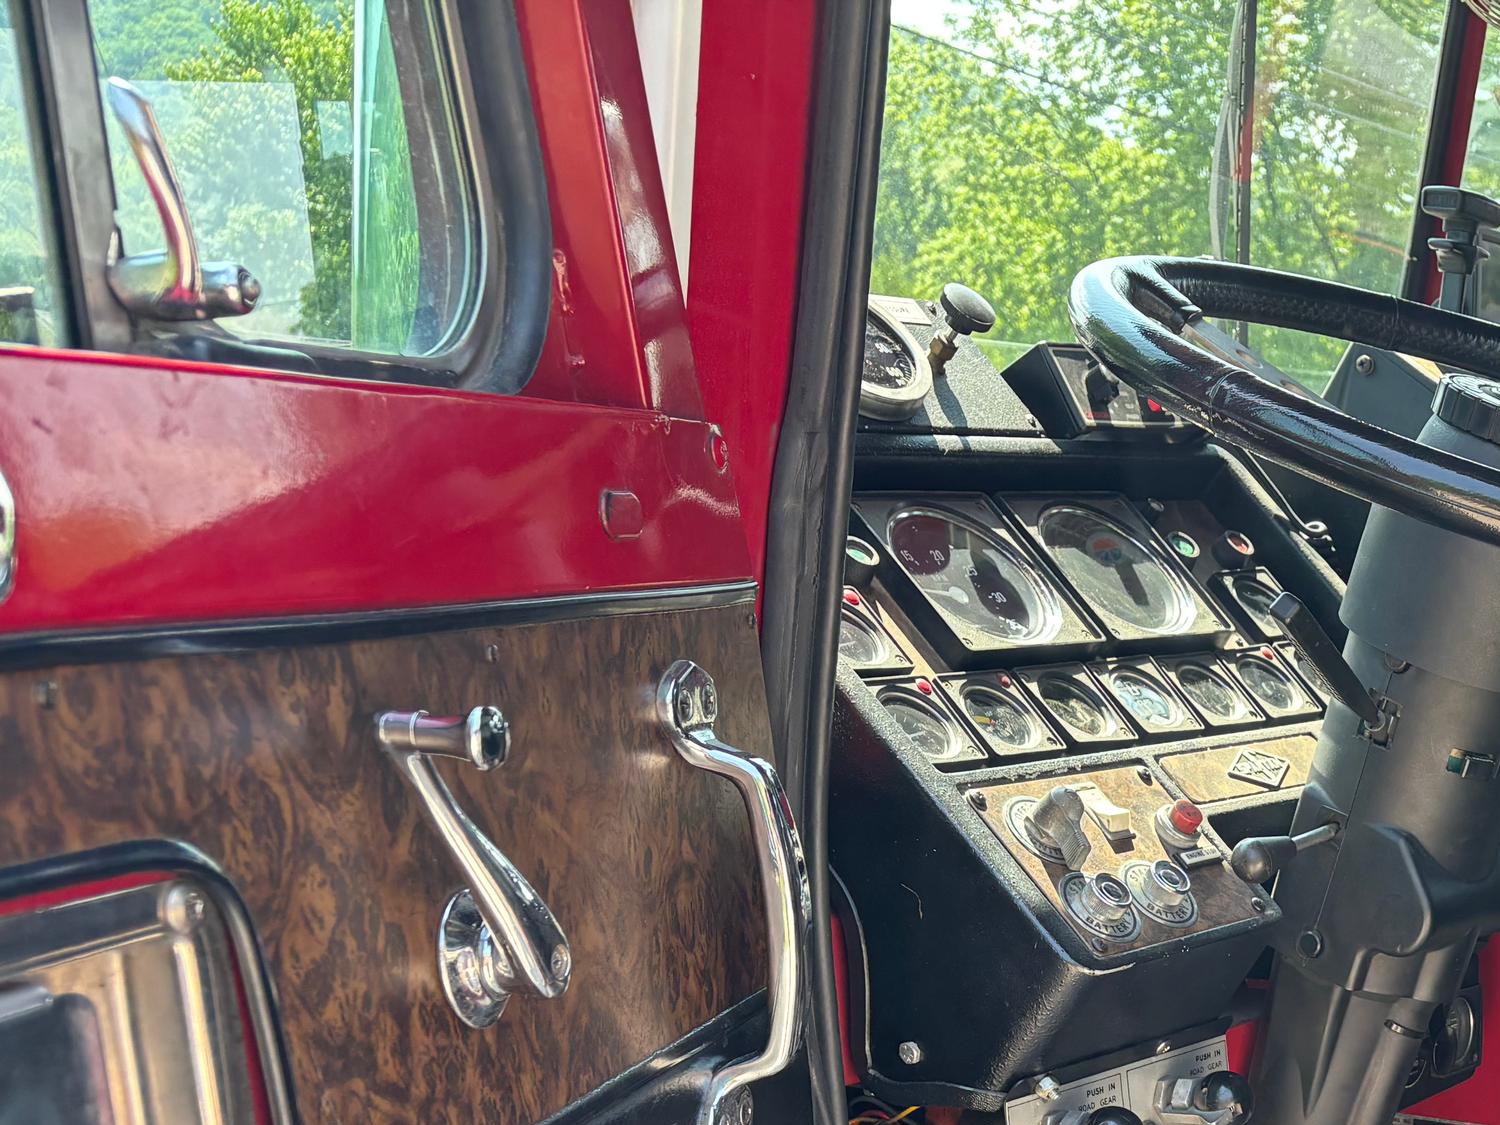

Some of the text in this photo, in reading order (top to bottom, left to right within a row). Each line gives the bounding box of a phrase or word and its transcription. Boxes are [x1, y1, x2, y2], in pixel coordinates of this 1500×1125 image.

[900, 550, 914, 561] 15
[930, 550, 945, 561] 20
[991, 592, 1007, 603] 30
[1146, 898, 1190, 920] BATTERY
[1086, 909, 1132, 934] BATTERY
[1195, 1049, 1221, 1062] PUSH IN
[1207, 1060, 1222, 1071] GEAR
[1086, 1082, 1116, 1098] PUSH IN
[1078, 1095, 1117, 1112] ROAD GEAR
